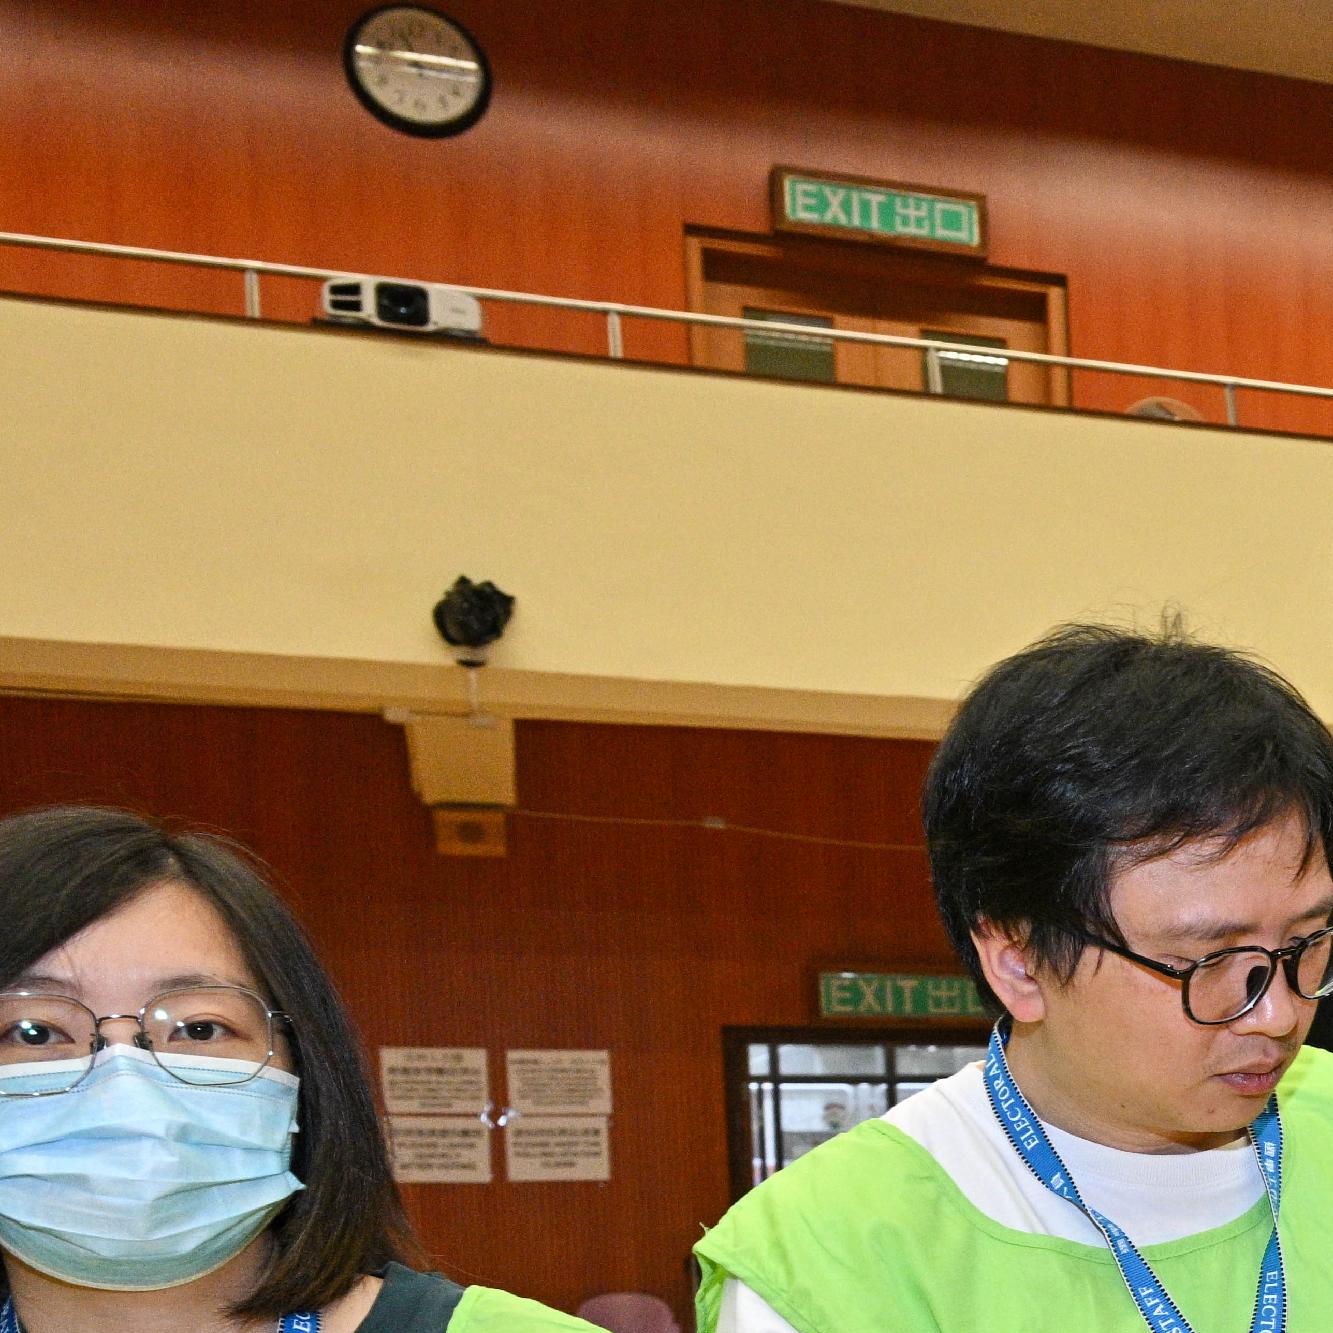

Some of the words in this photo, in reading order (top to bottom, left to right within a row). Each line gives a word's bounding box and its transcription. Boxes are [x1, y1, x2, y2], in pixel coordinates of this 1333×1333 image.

[796, 183, 886, 230] EXIT
[895, 196, 969, 240] 出口
[831, 979, 919, 1014] EXIT
[984, 1053, 1040, 1151] ELECTORAL
